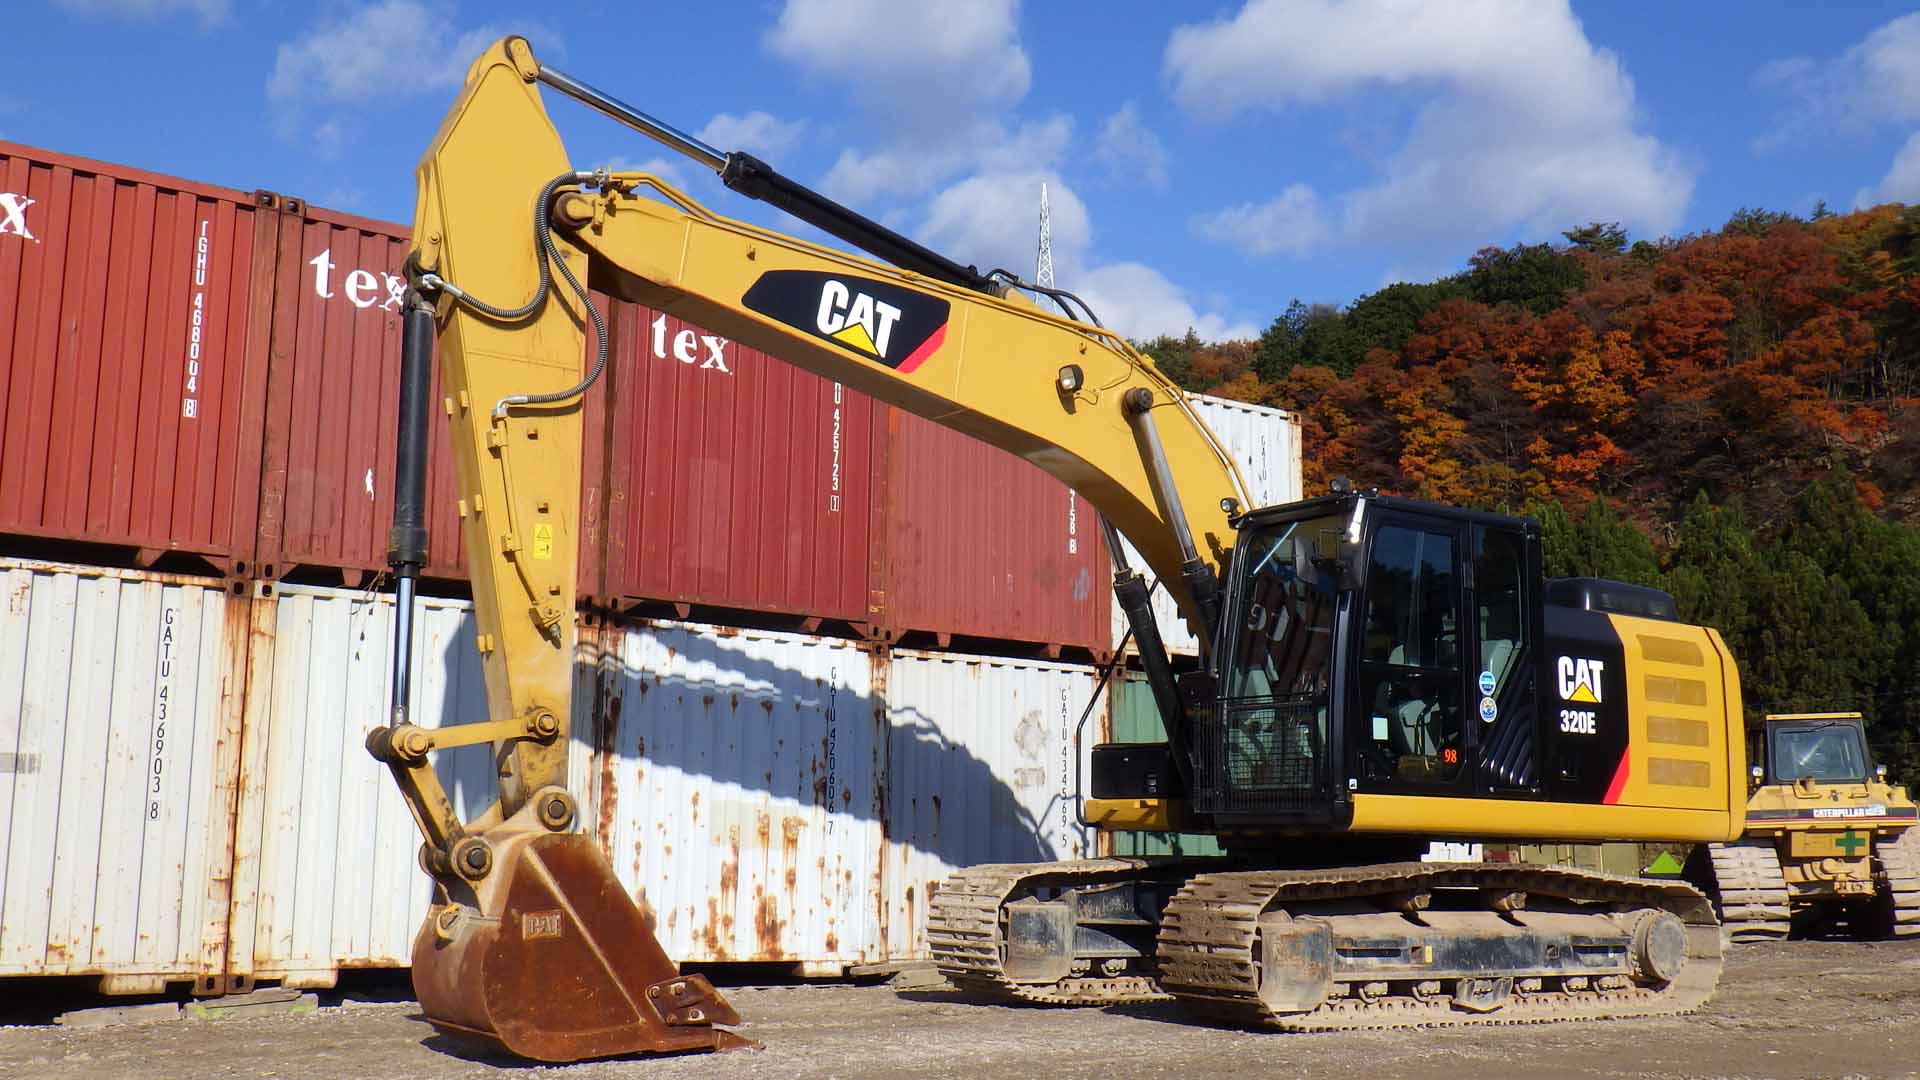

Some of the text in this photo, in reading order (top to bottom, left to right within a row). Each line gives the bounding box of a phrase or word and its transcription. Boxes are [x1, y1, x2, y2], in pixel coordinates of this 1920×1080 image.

[187, 292, 203, 393] 468004
[816, 279, 902, 359] CAT
[184, 399, 197, 417] 8
[832, 408, 841, 491] 425723
[1557, 655, 1604, 703] CAT
[149, 608, 174, 819] GATU 436903 8
[1560, 709, 1596, 735] 320E
[828, 727, 837, 814] 420606
[1444, 749, 1457, 764] 98
[828, 820, 834, 835] 7
[1813, 807, 1865, 818] CATERPILLAR
